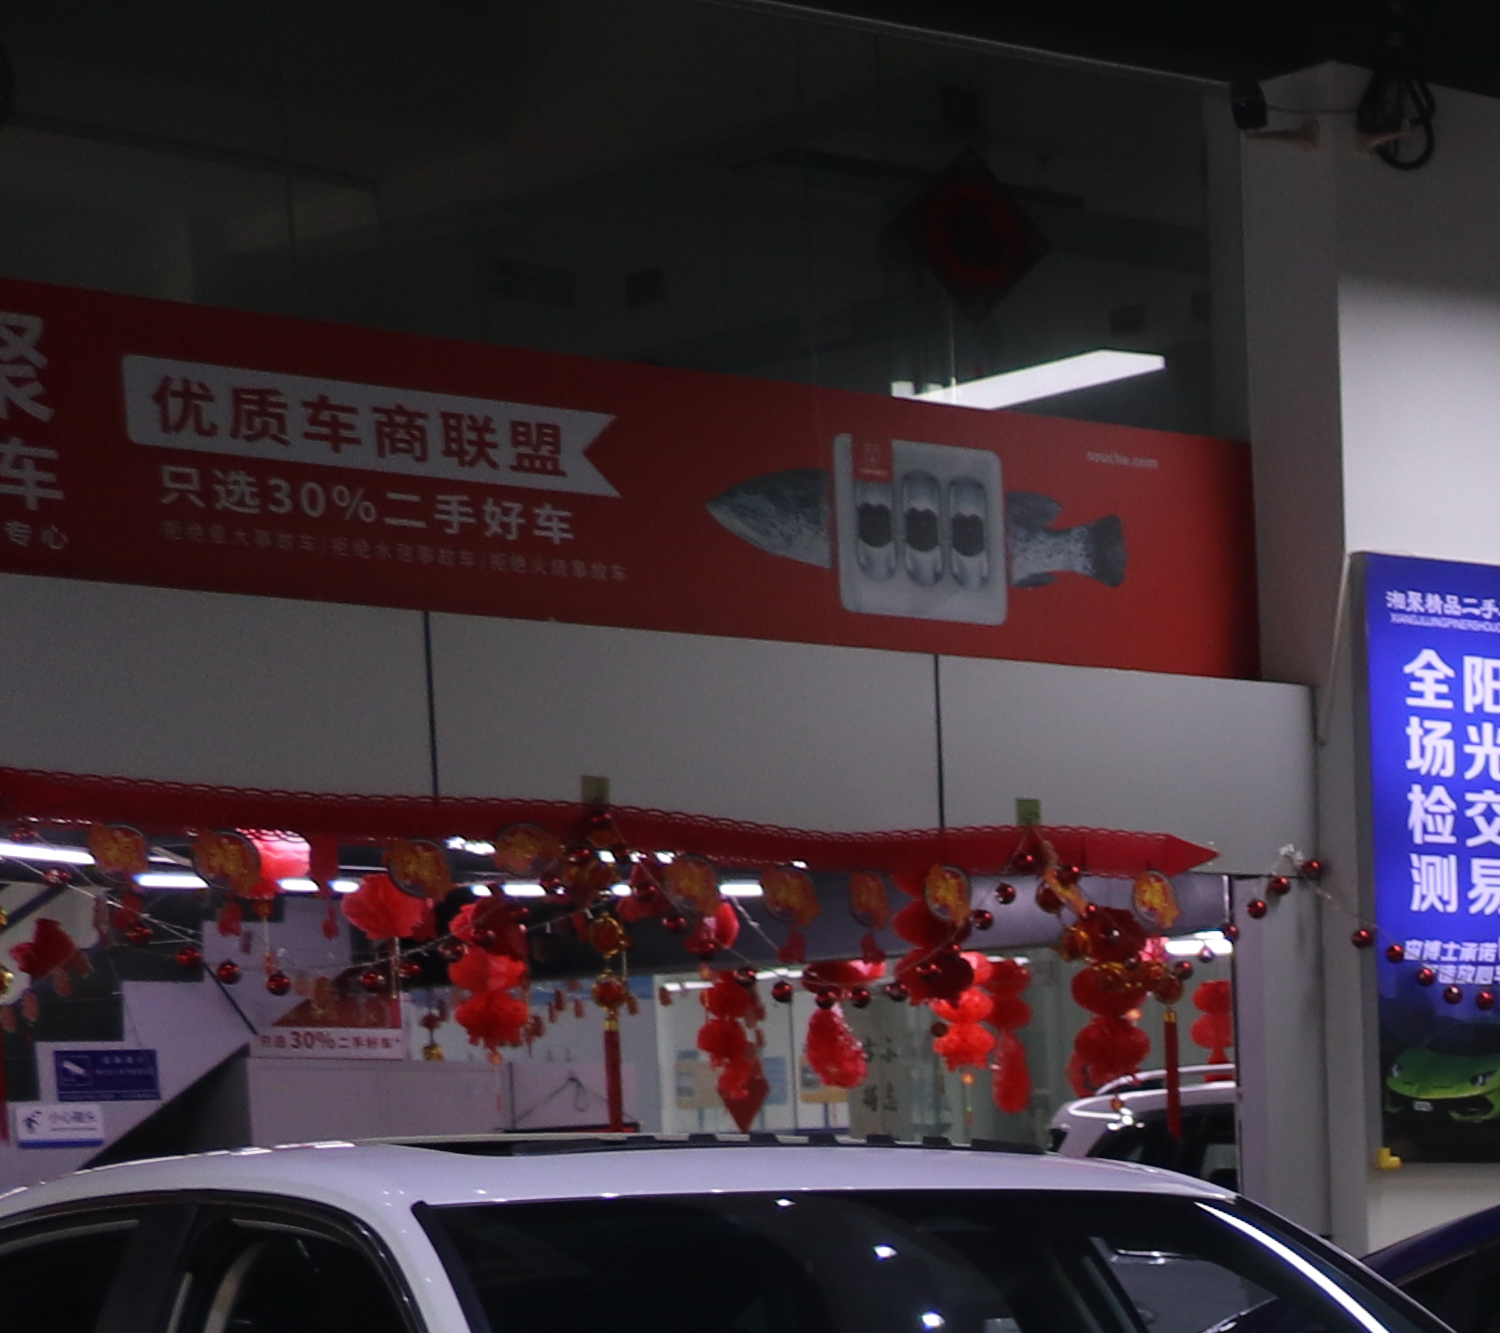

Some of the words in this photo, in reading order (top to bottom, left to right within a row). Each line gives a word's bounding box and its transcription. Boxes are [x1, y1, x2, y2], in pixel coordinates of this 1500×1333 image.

[152, 374, 569, 478] 优质车商联盟
[159, 464, 577, 546] 只选30%二手好车
[1402, 647, 1460, 914] 全场检测
